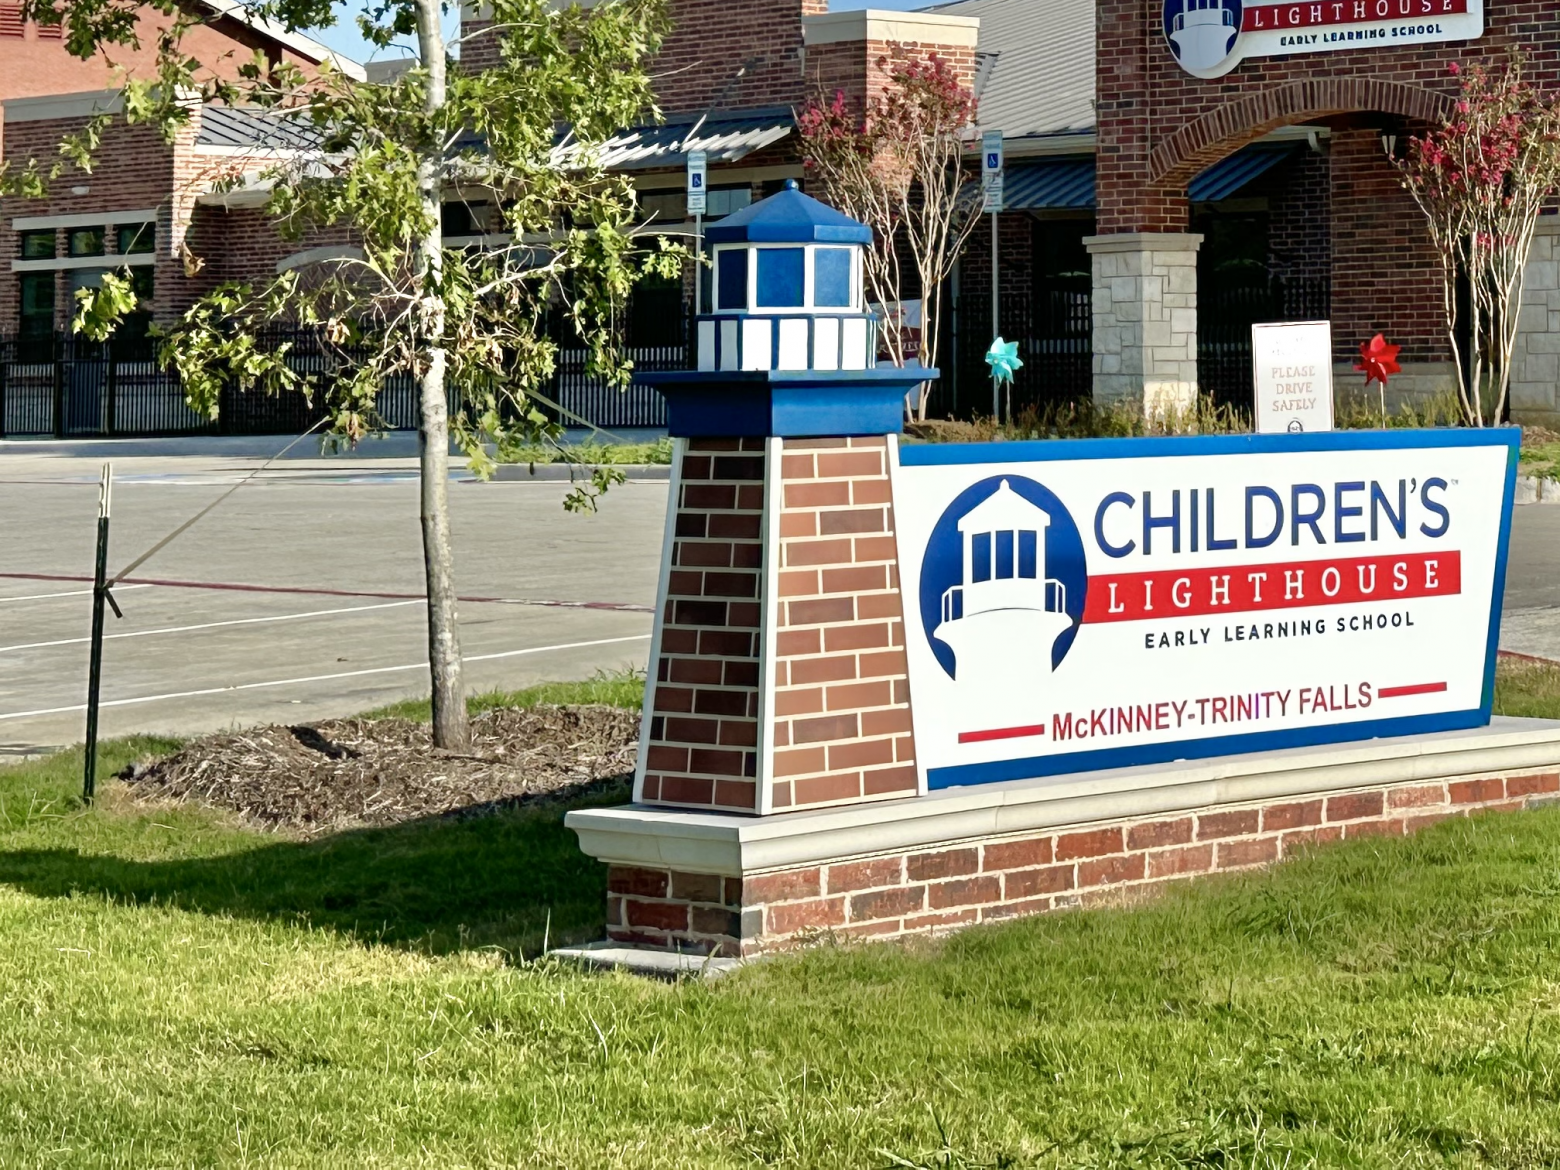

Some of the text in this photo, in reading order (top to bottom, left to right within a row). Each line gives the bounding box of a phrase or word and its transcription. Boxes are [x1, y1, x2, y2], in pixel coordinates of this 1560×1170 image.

[1280, 24, 1442, 47] EARLY LEARNING SCHOOL
[1271, 365, 1316, 379] PLEASE
[1276, 382, 1313, 395] DRIVE
[1272, 397, 1317, 412] SAFELY
[1094, 476, 1451, 558] CHILDREN'S
[1107, 559, 1439, 614] LIGHTHOUSE
[1145, 611, 1415, 650] EARLY LEARNING SCHOOL
[1052, 681, 1373, 743] McKINNEY-TRINITY FALLS
